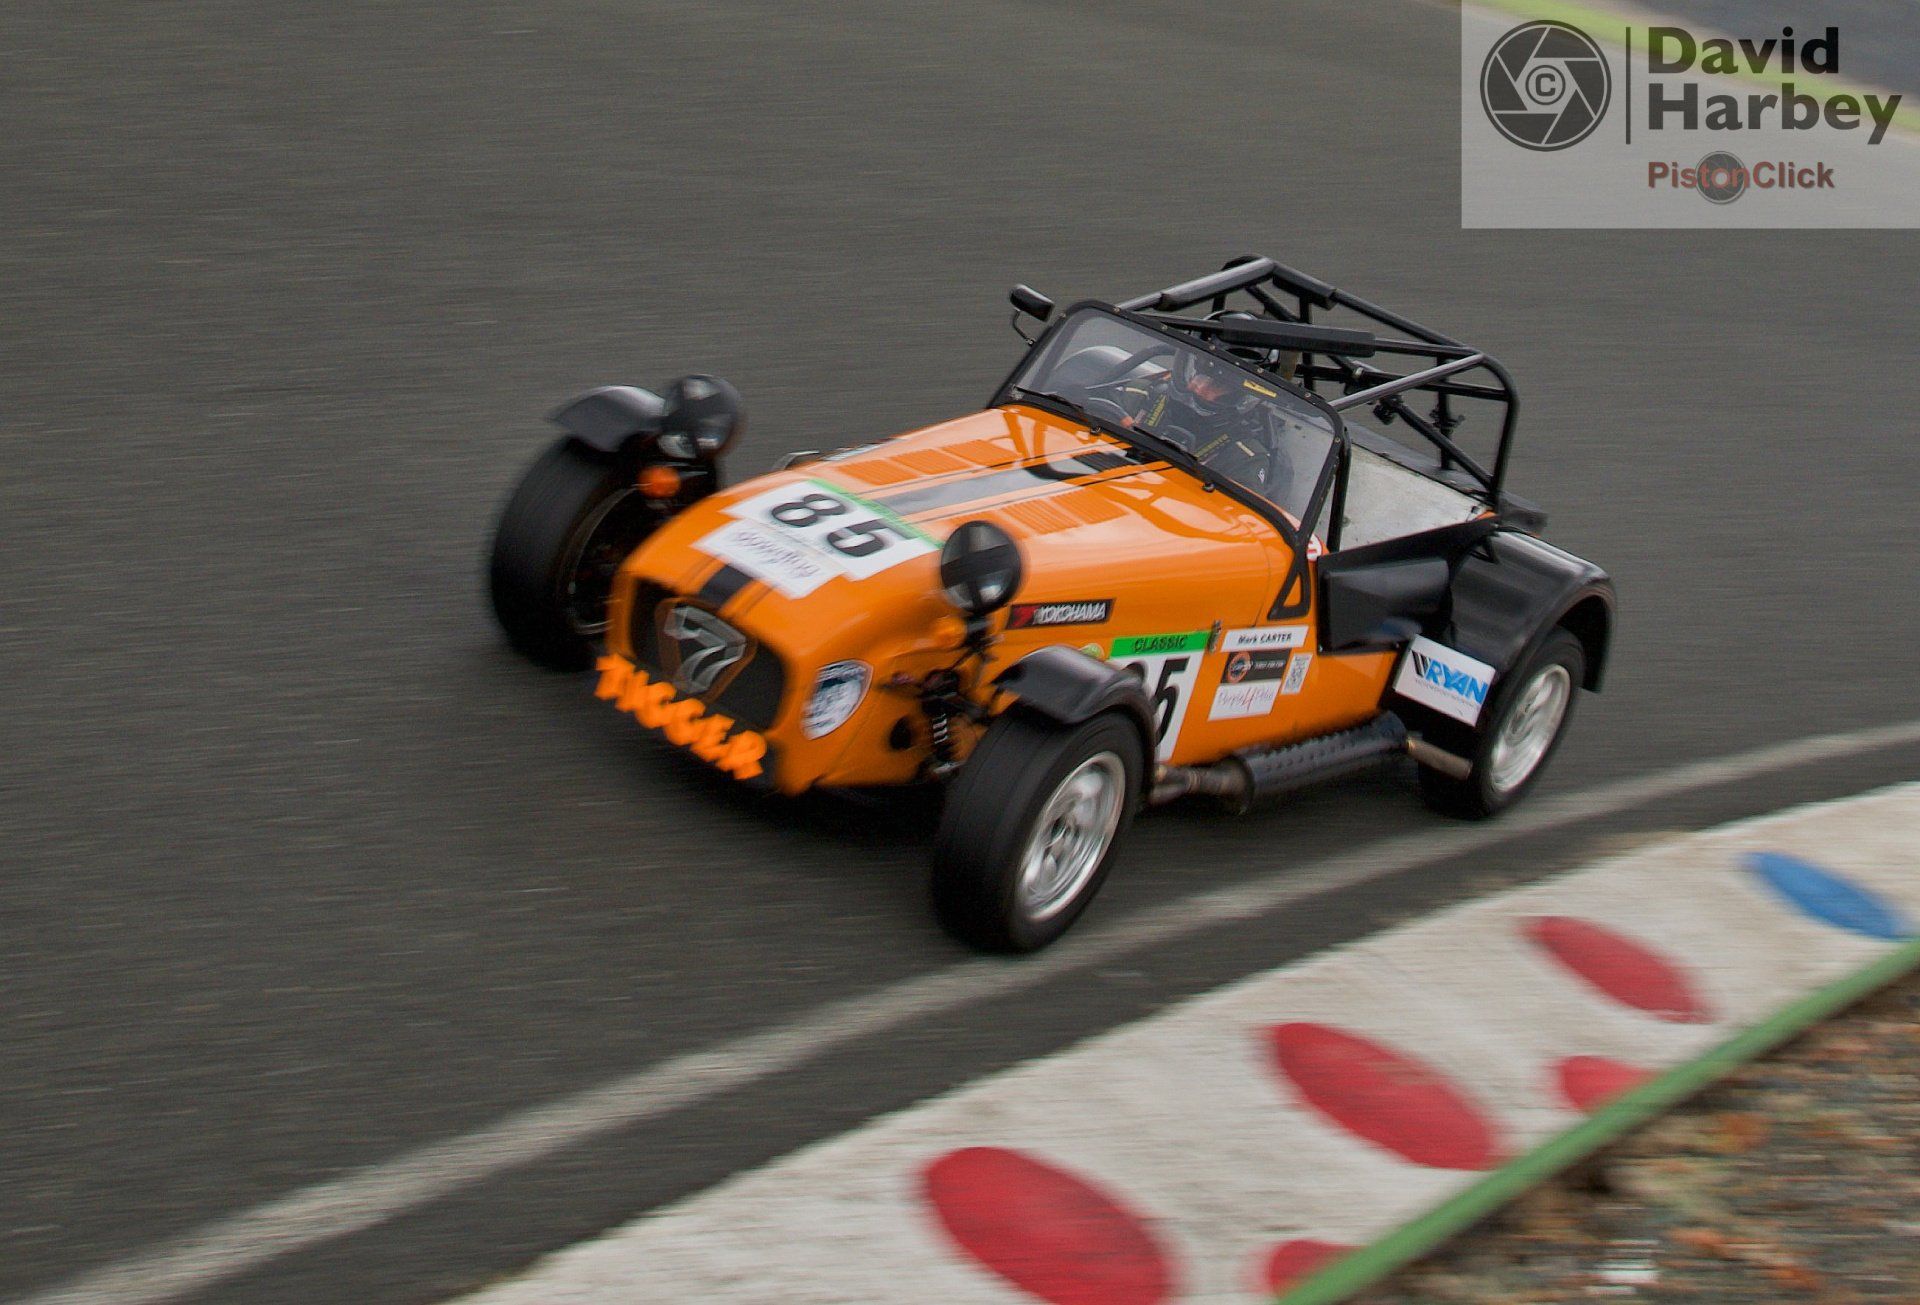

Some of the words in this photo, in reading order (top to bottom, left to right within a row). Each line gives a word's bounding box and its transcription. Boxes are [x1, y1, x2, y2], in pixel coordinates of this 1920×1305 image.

[771, 493, 918, 557] 85
[1036, 602, 1107, 625] YOKOHAMA
[1133, 634, 1188, 652] CLASSIC
[1260, 632, 1293, 644] CARTER
[1425, 658, 1489, 705] RYAN
